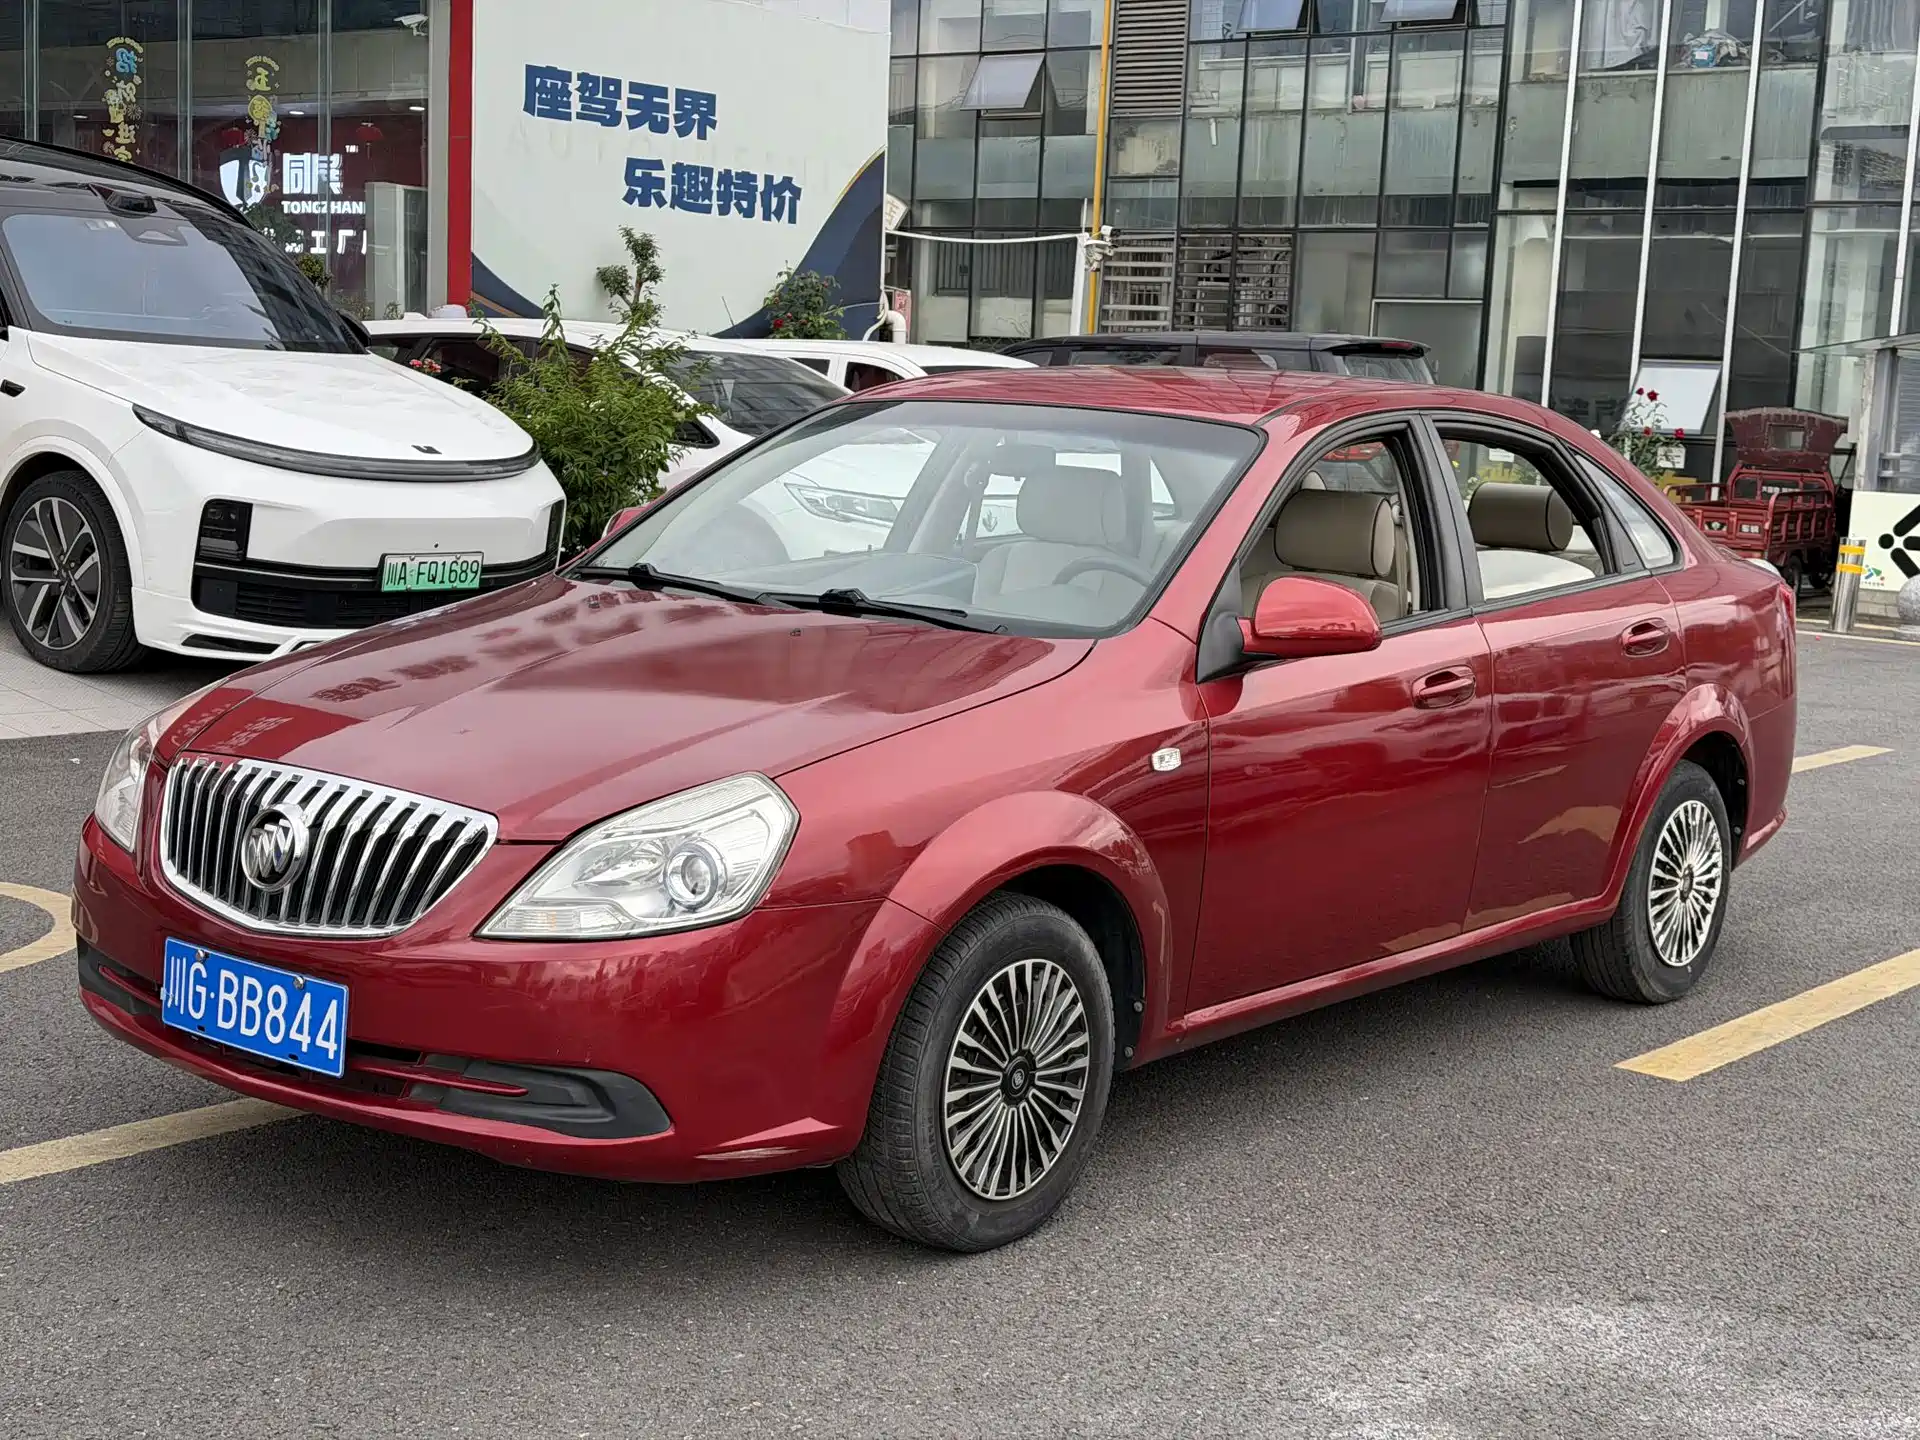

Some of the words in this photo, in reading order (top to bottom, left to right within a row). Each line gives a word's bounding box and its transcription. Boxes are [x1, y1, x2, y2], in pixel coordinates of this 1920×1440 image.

[523, 64, 717, 140] 座驾无界
[622, 157, 802, 225] 乐趣特价
[386, 561, 407, 586] 川A
[416, 560, 480, 585] FQ1689
[167, 956, 338, 1060] 川G·BB844
